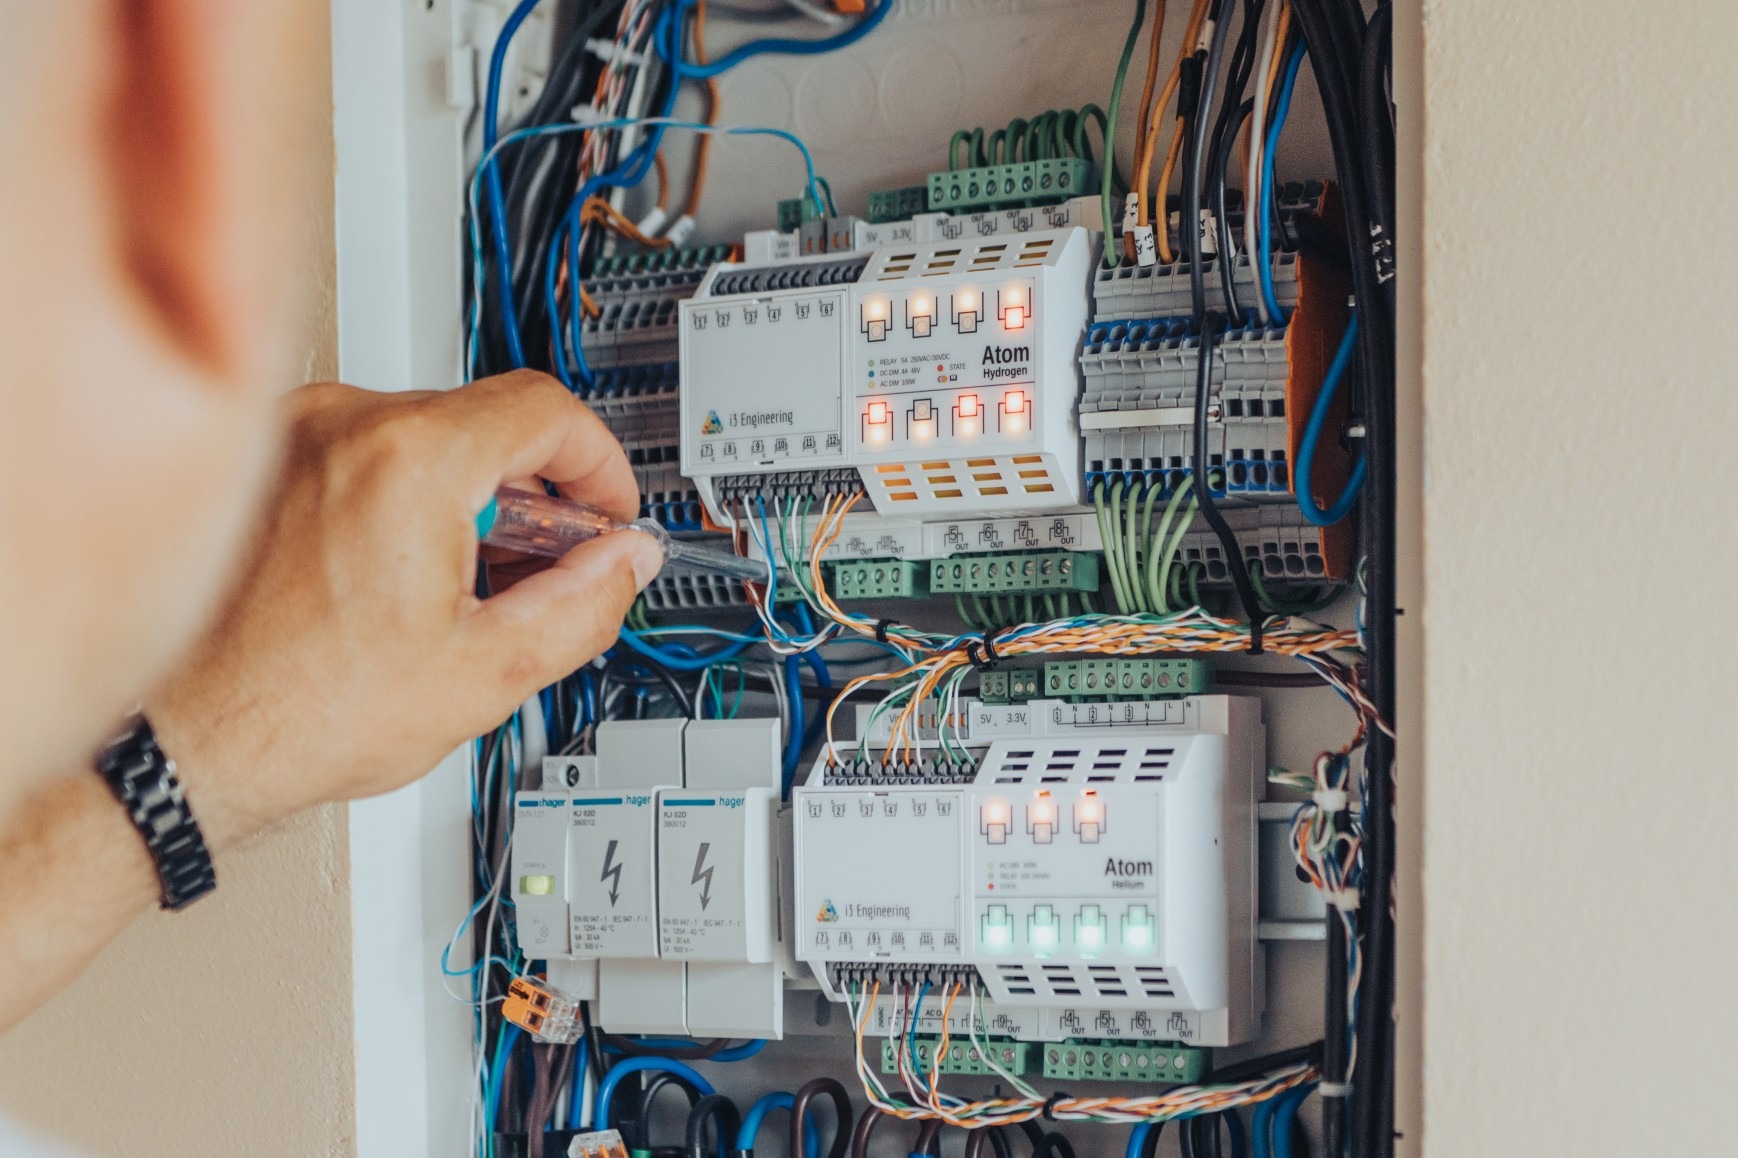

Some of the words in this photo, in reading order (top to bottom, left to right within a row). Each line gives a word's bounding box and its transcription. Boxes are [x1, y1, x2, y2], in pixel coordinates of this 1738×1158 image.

[1007, 211, 1020, 219] OUT
[937, 218, 950, 226] OUT
[982, 346, 1029, 365] Atom
[880, 358, 897, 366] RELAY
[984, 366, 1027, 380] Hydrogen
[729, 413, 738, 427] i3
[741, 410, 793, 428] Engineering
[950, 528, 957, 540] 5
[985, 527, 992, 539] 6
[1021, 524, 1027, 537] 7
[1055, 522, 1063, 535] 8
[980, 714, 992, 724] 5V
[1007, 712, 1026, 723] 3.3V
[626, 795, 651, 806] hager
[719, 796, 744, 808] hager
[1105, 857, 1153, 877] Atom
[1112, 880, 1144, 889] Helium
[846, 904, 853, 918] i3
[856, 904, 910, 920] Engineering
[1067, 1012, 1073, 1023] 4
[1101, 1012, 1108, 1025] 5
[1138, 1013, 1144, 1027] 6
[1174, 1014, 1181, 1028] 7
